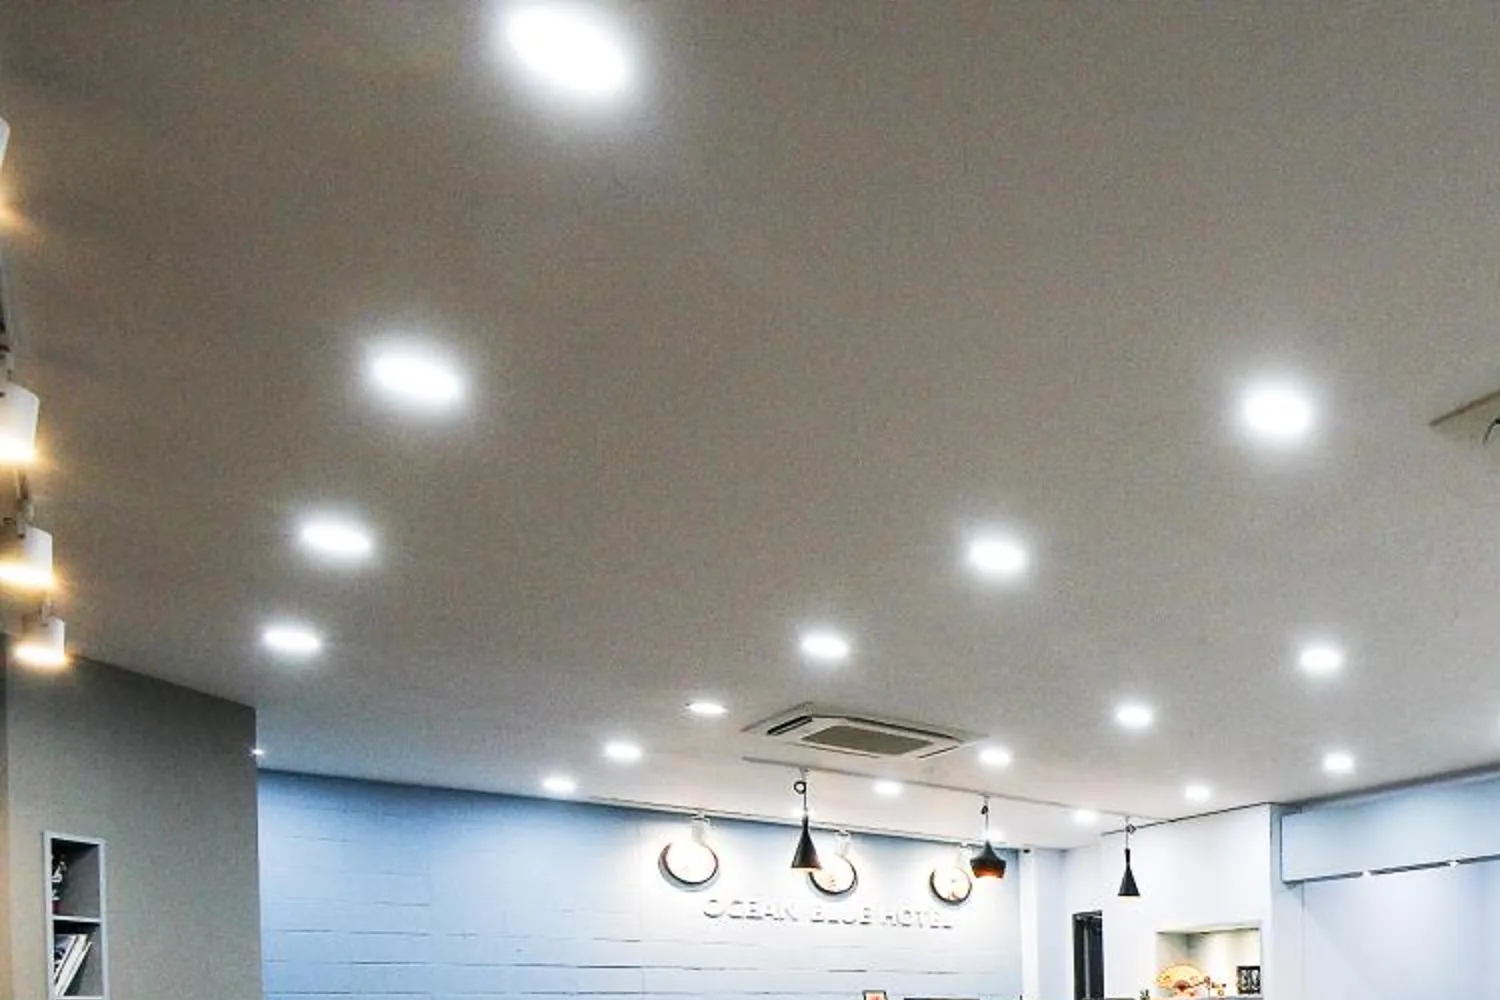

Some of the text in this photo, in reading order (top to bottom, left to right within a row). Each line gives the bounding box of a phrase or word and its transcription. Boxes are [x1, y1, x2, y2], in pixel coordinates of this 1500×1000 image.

[703, 898, 955, 930] OCEAN BLUE HOTEL
